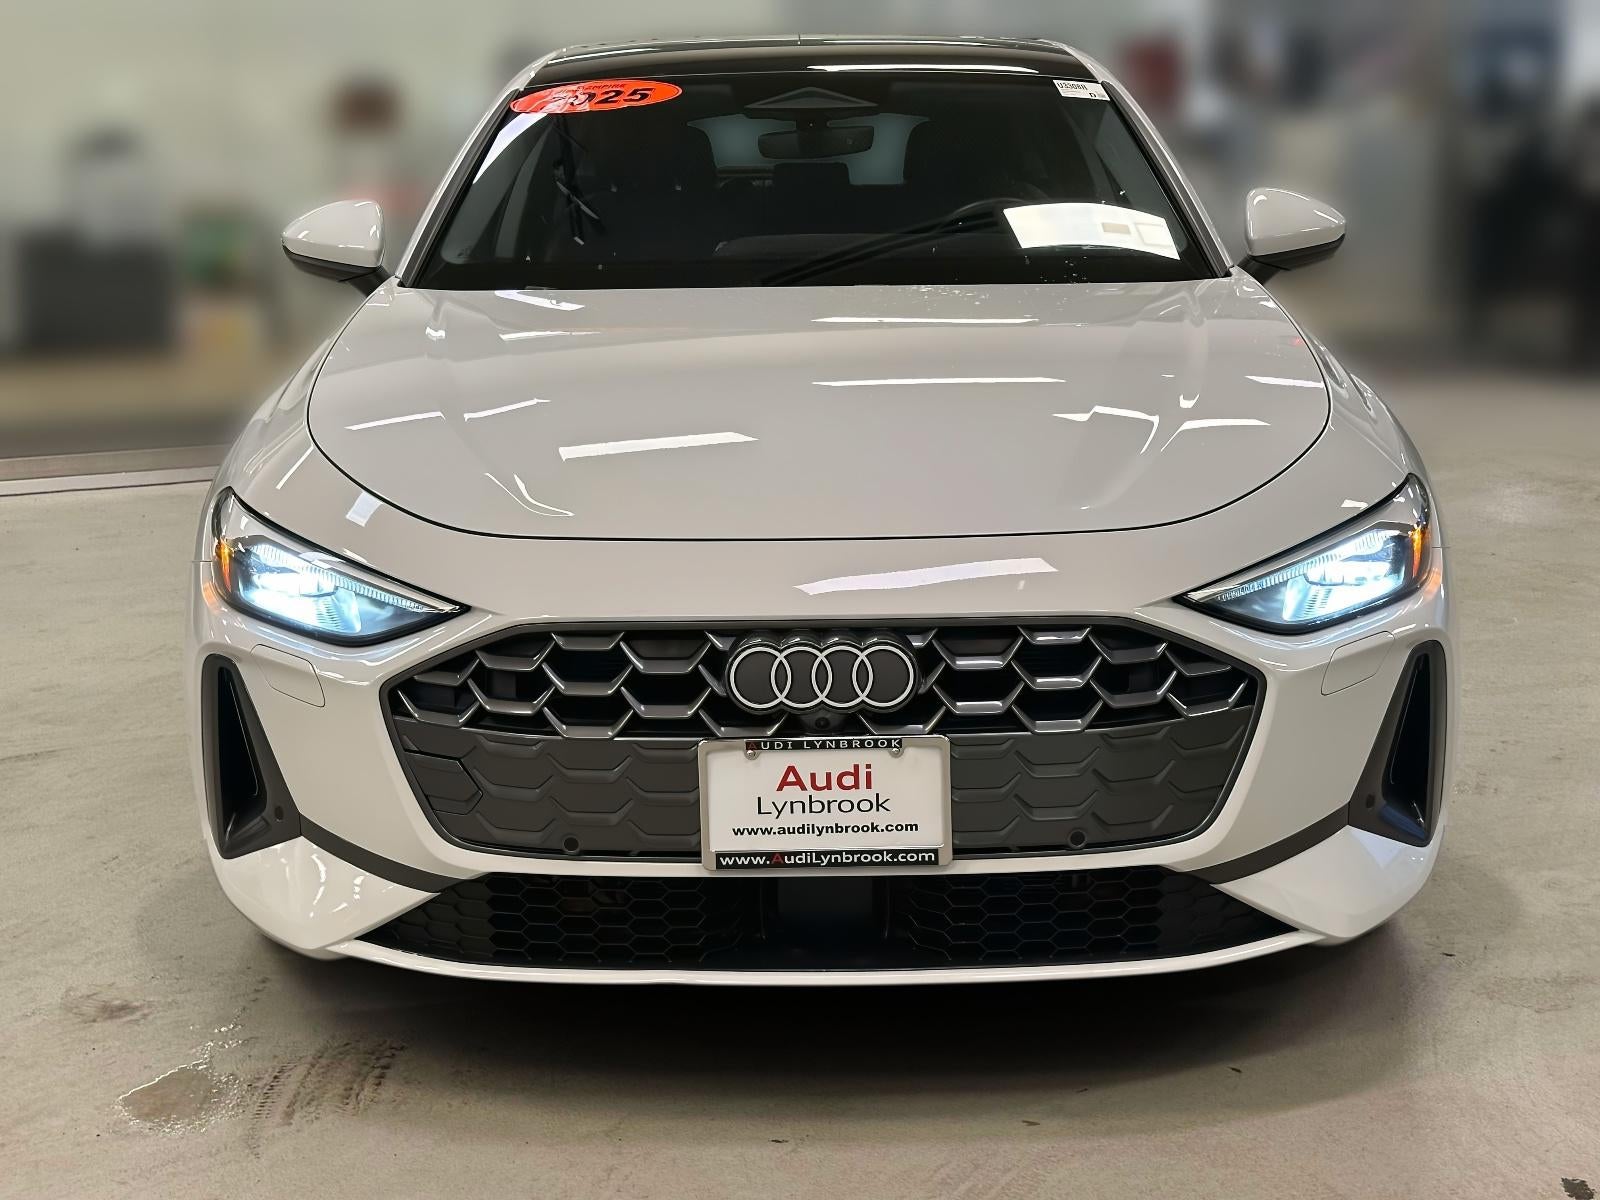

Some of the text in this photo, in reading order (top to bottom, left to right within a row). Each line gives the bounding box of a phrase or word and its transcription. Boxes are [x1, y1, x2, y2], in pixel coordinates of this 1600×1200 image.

[747, 738, 901, 750] AUDI LYNBROOK
[776, 763, 873, 792] Audi
[757, 793, 891, 819] Lynbrook
[732, 822, 919, 837] www.audilynbrook.com
[719, 850, 936, 866] www.AudiLynbrook.com
